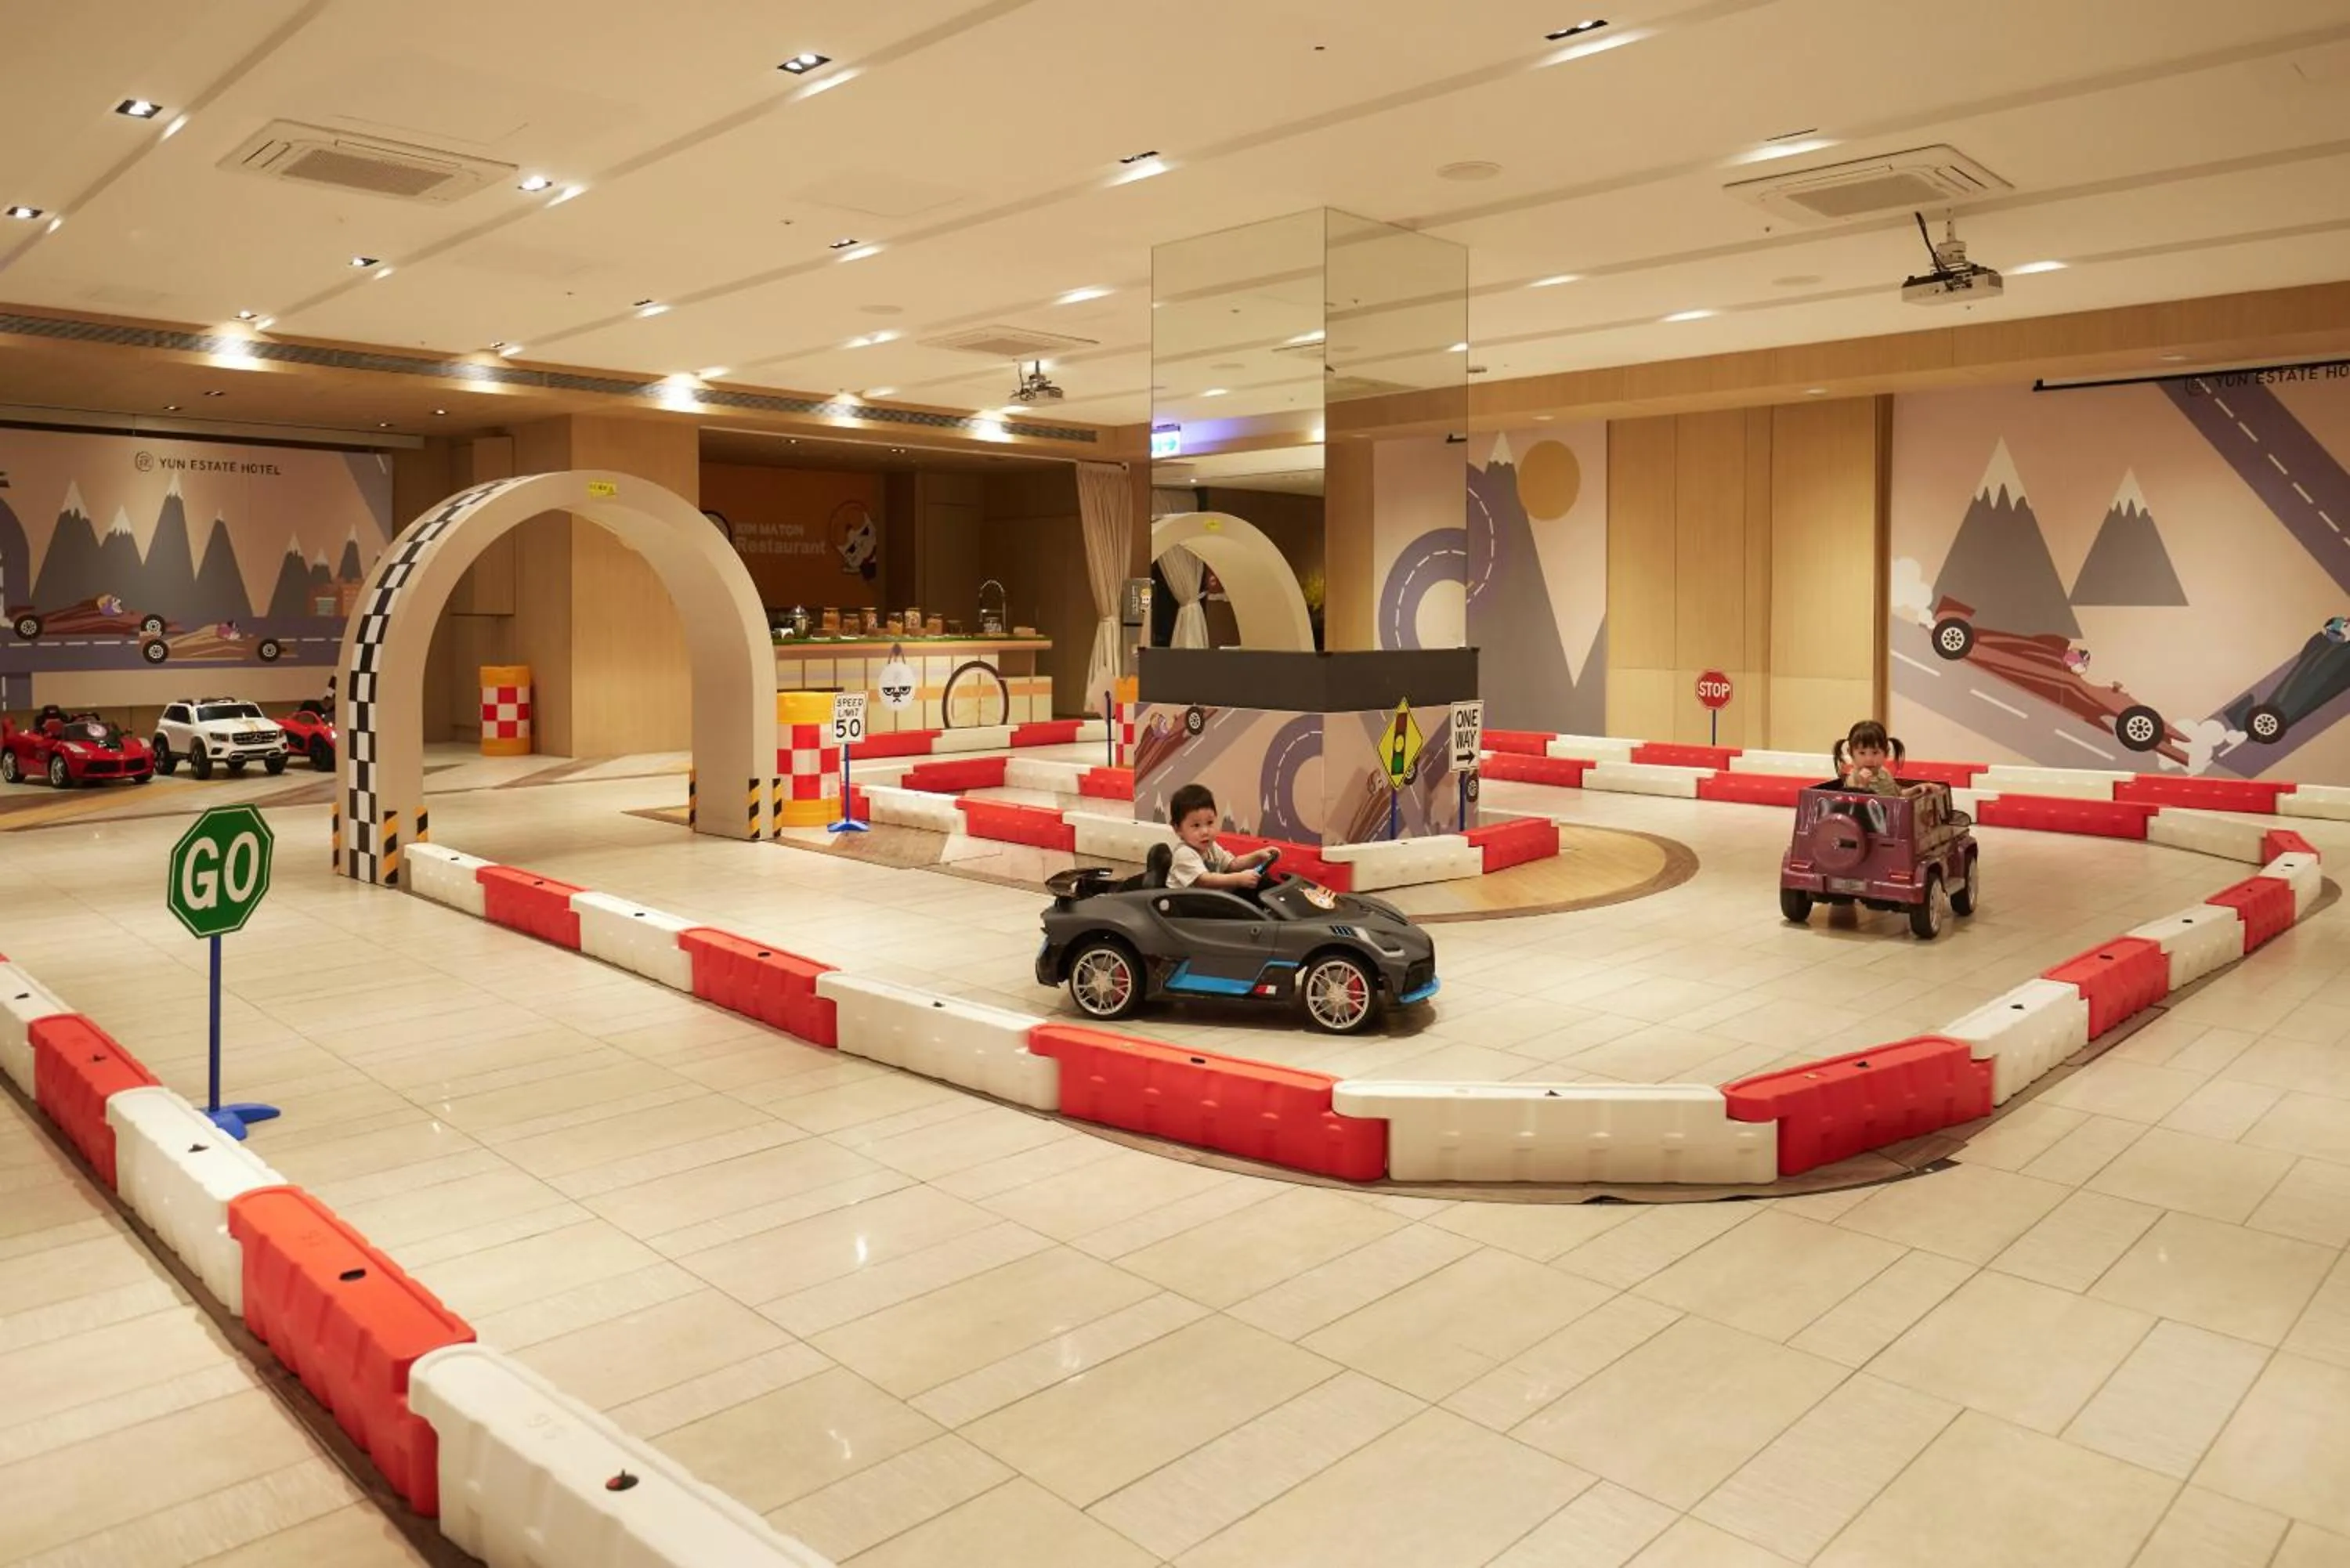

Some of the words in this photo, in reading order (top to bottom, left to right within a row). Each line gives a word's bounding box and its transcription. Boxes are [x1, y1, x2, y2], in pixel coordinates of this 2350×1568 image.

[2215, 374, 2247, 388] YUN
[2255, 368, 2318, 385] ESTATE
[160, 457, 186, 469] YUN
[190, 459, 237, 472] ESTATE
[241, 463, 282, 475] HOTEL
[736, 537, 826, 555] Restaurant
[1698, 681, 1730, 698] STOP
[836, 698, 864, 707] SPEED
[837, 707, 859, 717] LIMIT
[1455, 708, 1478, 728] ONE
[835, 718, 861, 739] 50
[1455, 729, 1477, 749] WAY
[182, 831, 259, 910] GO
